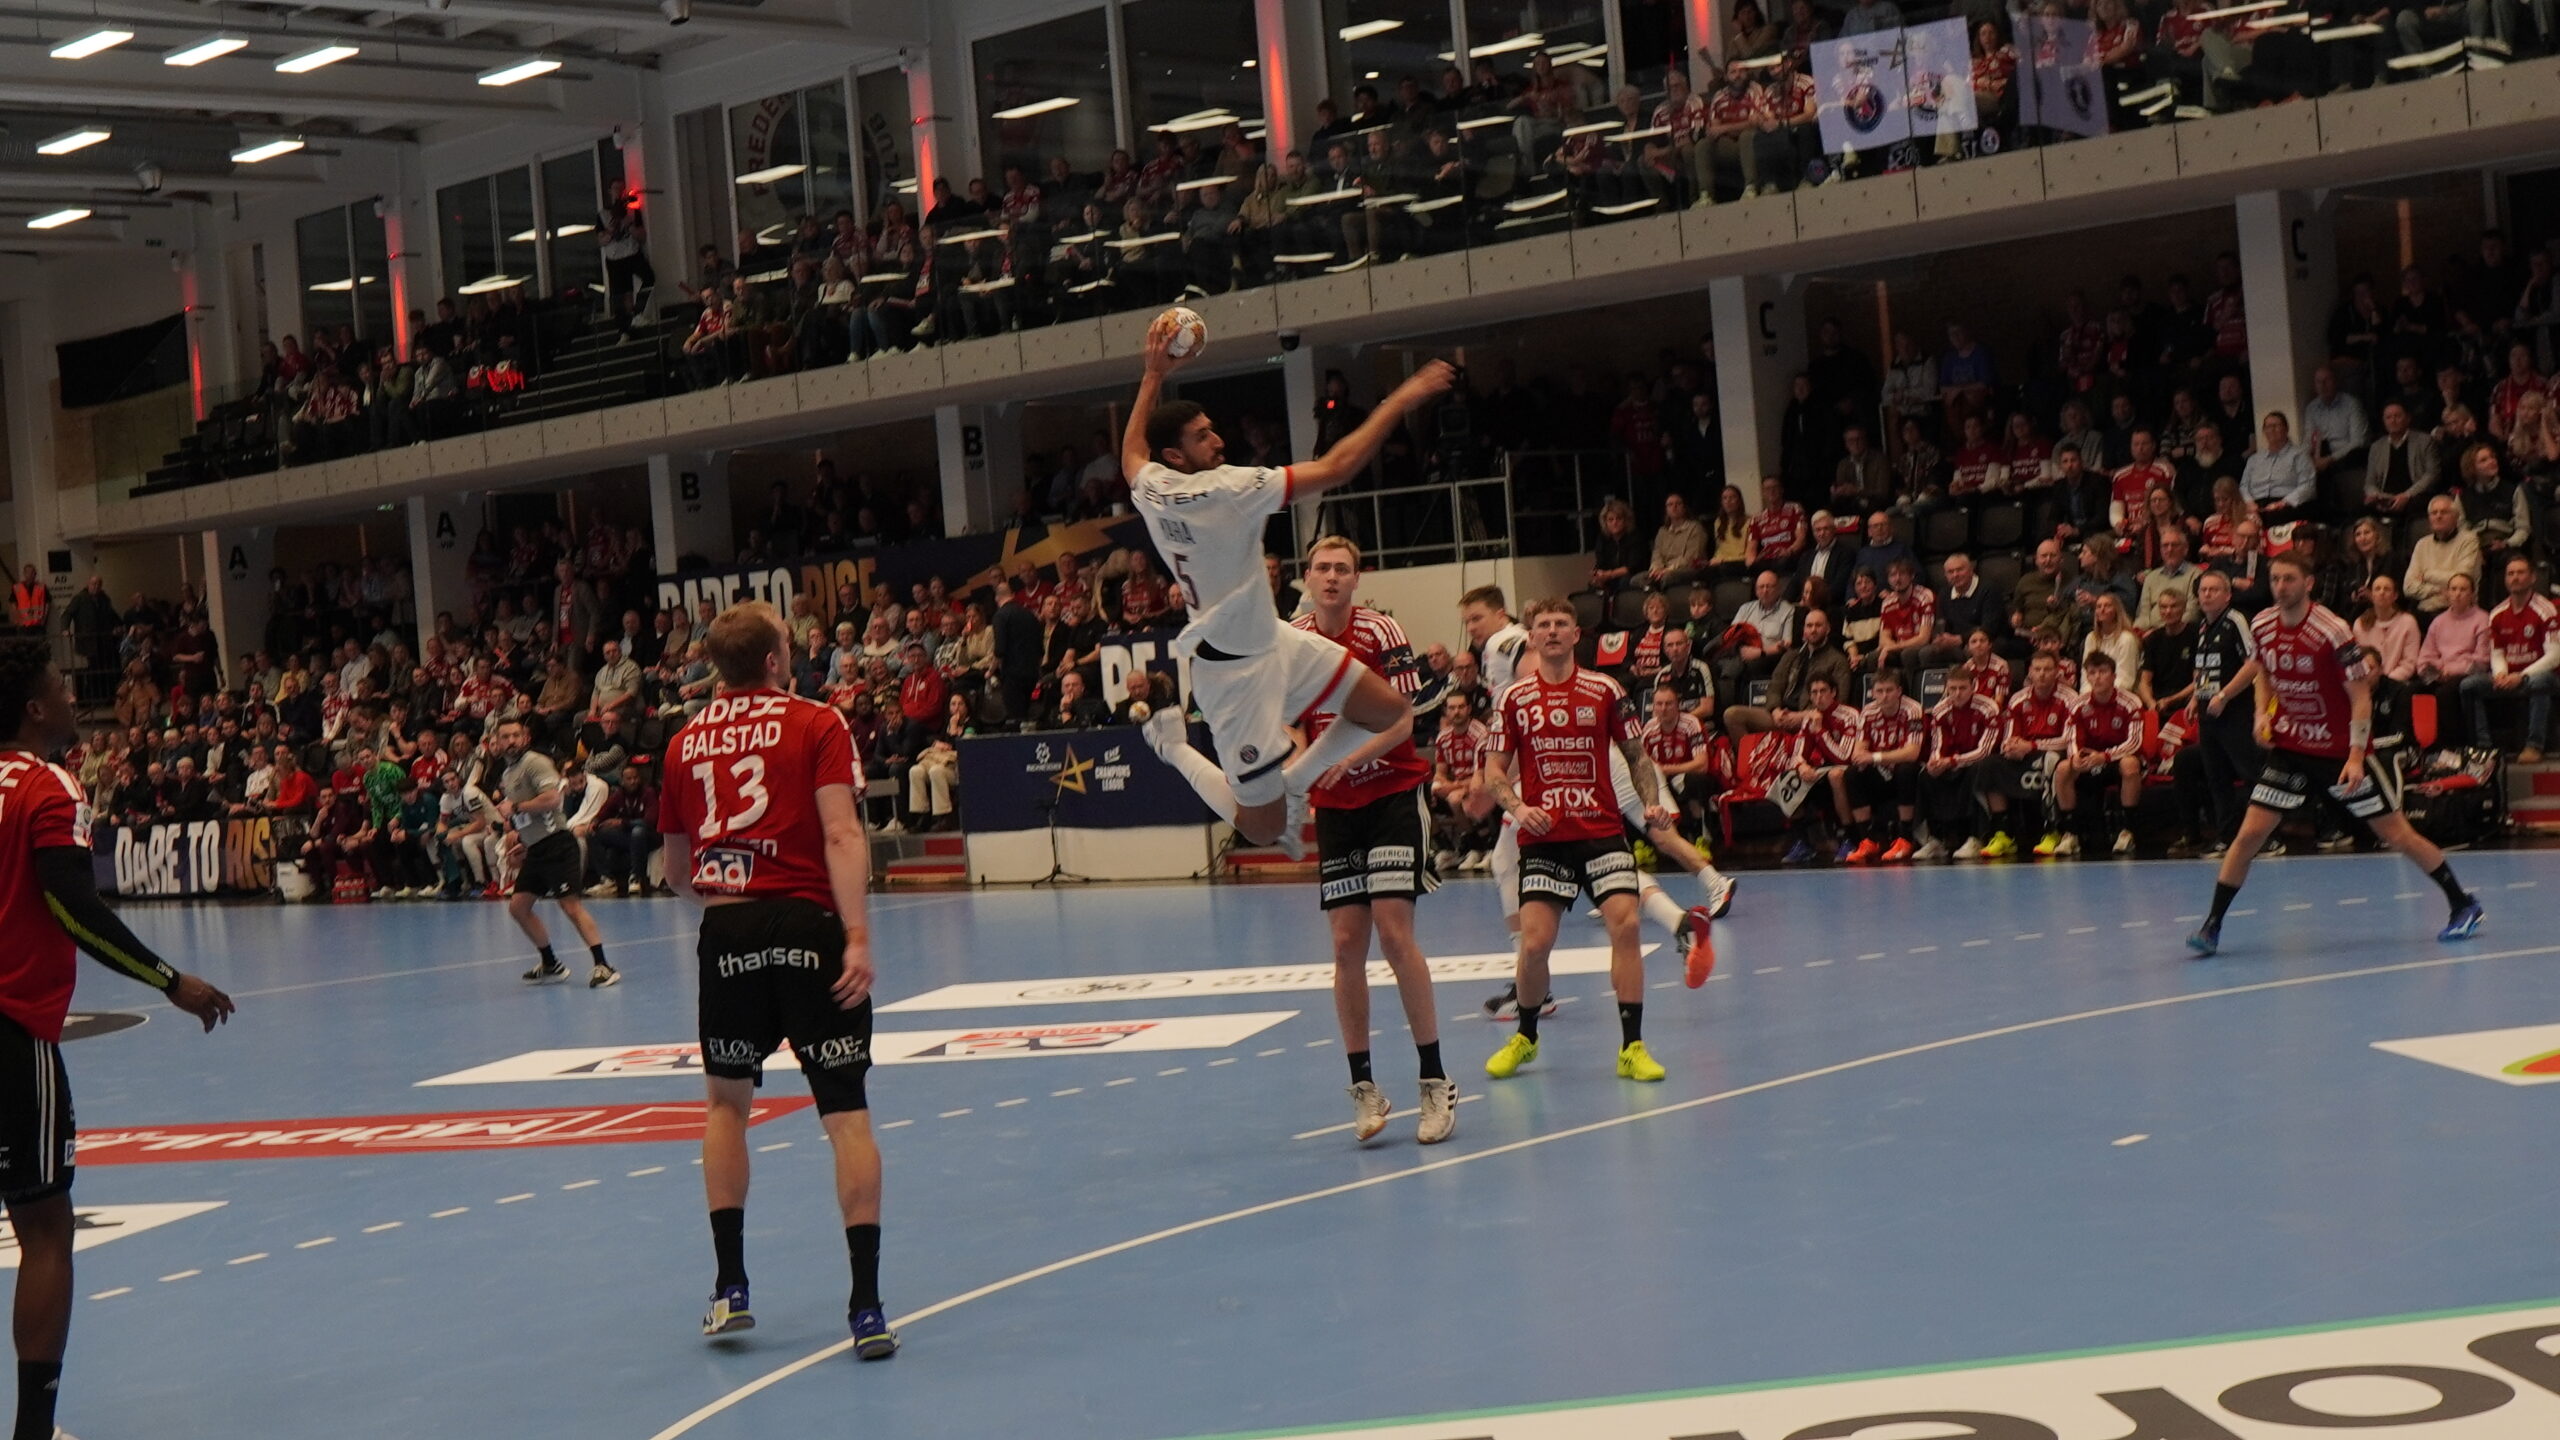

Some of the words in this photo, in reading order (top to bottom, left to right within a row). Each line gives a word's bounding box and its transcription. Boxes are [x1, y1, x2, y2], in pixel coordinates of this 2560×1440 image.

[2292, 219, 2307, 261] C
[1760, 301, 1776, 339] C
[962, 425, 983, 457] B
[681, 472, 700, 500] B
[436, 511, 456, 538] A
[229, 546, 248, 569] A
[1515, 704, 1545, 736] 93
[681, 720, 782, 763] BALSTAD
[1531, 736, 1595, 751] thansen
[692, 754, 770, 841] 13
[115, 822, 182, 895] DARE
[187, 819, 221, 893] TO
[225, 816, 276, 890] RIS
[1322, 875, 1368, 897] PHILI
[1523, 876, 1577, 896] PHILIPS
[718, 946, 820, 979] thansen
